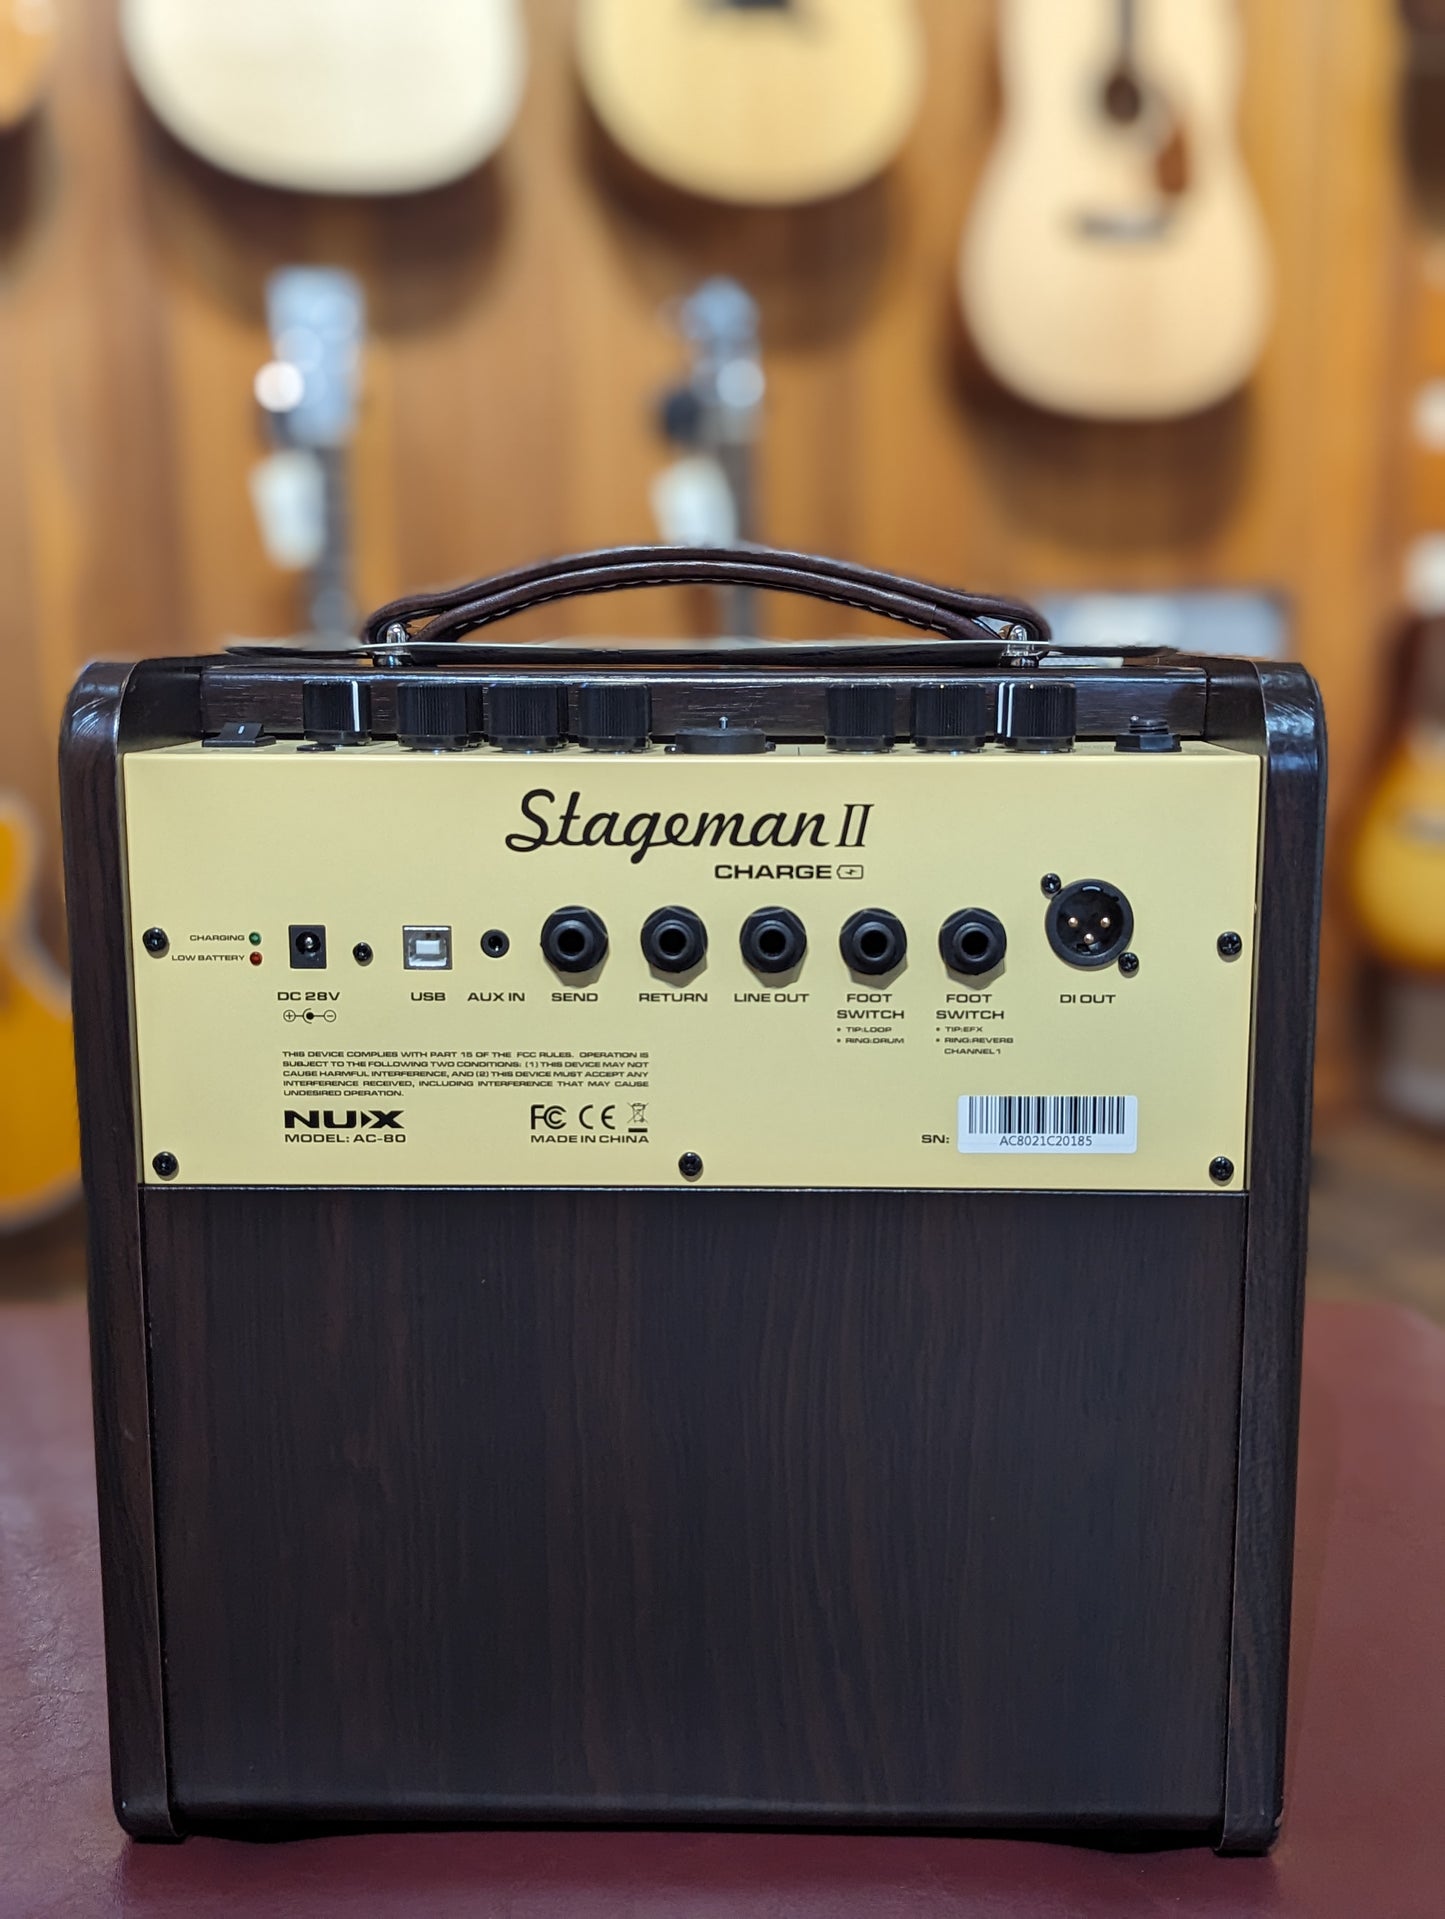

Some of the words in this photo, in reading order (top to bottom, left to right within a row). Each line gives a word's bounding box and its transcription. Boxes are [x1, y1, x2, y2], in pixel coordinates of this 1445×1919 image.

[505, 789, 829, 864] Stageman
[835, 804, 874, 847] II
[715, 865, 832, 879] CHARGE
[190, 934, 245, 942] CHARGING
[172, 954, 196, 962] LOW
[198, 954, 244, 962] BATTERY
[278, 992, 301, 1001] DC
[305, 992, 340, 1001] 28V
[411, 992, 446, 1001] USB
[467, 992, 504, 1001] AUX
[509, 993, 525, 1001] IN
[552, 993, 598, 1002] SEND
[639, 993, 708, 1002] RETURN
[734, 993, 770, 1002] LINE
[774, 993, 809, 1002] OUT
[847, 994, 892, 1003] FOOT
[946, 994, 992, 1003] FOOT
[1060, 994, 1076, 1003] DI
[1080, 994, 1116, 1004] OUT
[837, 1010, 904, 1019] SWITCH
[936, 1010, 1004, 1019] SWITCH
[846, 1026, 892, 1034] TIP:LOOP
[945, 1025, 983, 1033] TIP:EFX
[845, 1037, 904, 1045] RING:DRUM
[944, 1036, 1013, 1044] RING:REVERB
[282, 1050, 305, 1058] THIS
[308, 1050, 344, 1058] DEVICE
[347, 1050, 398, 1058] COMPLIES
[461, 1051, 473, 1059] 15
[492, 1051, 511, 1059] THE
[517, 1051, 536, 1059] FCC
[539, 1051, 574, 1059] RULES.
[579, 1051, 637, 1059] OPERATION
[640, 1051, 649, 1059] IS
[283, 1060, 328, 1068] SUBJECT
[330, 1060, 344, 1068] TO
[346, 1060, 366, 1068] THE
[368, 1060, 428, 1068] FOLLOWING
[430, 1060, 455, 1068] TWO
[525, 1060, 538, 1069] (1)
[627, 1061, 649, 1069] NOT
[283, 1070, 317, 1078] CAUSE
[320, 1070, 369, 1078] HARMFUL
[372, 1070, 449, 1079] INTERFERENCE,
[451, 1070, 474, 1078] AND
[476, 1070, 489, 1078] (2)
[491, 1070, 513, 1078] THIS
[515, 1070, 551, 1078] DEVICE
[553, 1070, 583, 1078] MUST
[585, 1070, 624, 1078] ACCEPT
[363, 1080, 414, 1089] RECEIVED,
[419, 1080, 474, 1088] INCLUDING
[478, 1080, 552, 1088] INTERFERENCE
[557, 1080, 584, 1088] THAT
[588, 1080, 610, 1088] MAY
[614, 1080, 649, 1088] CAUSE
[284, 1089, 341, 1097] UNDESIRED
[344, 1089, 404, 1097] OPERATION.
[579, 1105, 615, 1130] CE
[285, 1134, 349, 1142] MODEL:
[353, 1134, 406, 1143] AC-80
[531, 1135, 577, 1143] MADE
[581, 1135, 596, 1143] IN
[599, 1135, 649, 1143] CHINA
[922, 1135, 949, 1143] SN:
[999, 1135, 1092, 1146] AC8021C20185
